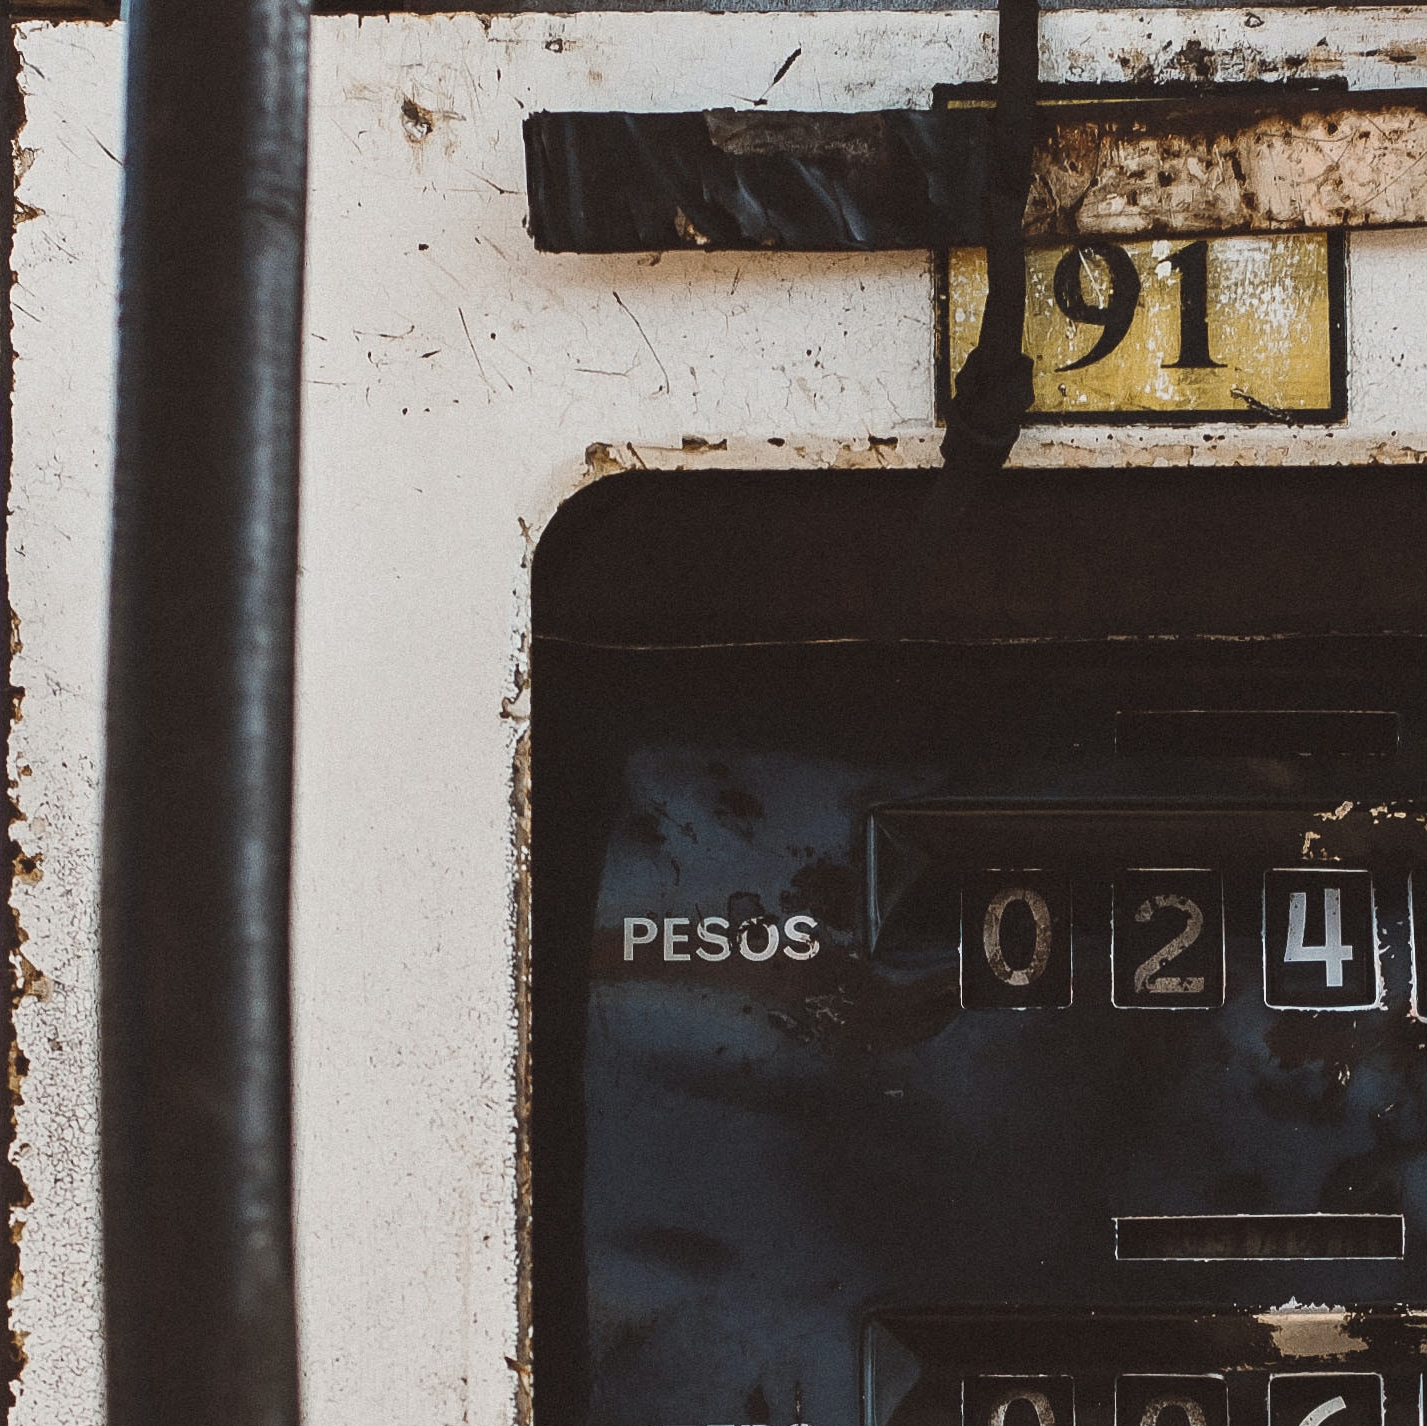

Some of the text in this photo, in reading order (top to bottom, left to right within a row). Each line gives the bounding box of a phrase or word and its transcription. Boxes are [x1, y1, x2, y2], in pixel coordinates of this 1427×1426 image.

[1054, 240, 1229, 372] 91
[622, 913, 821, 963] PESOS
[1280, 887, 1355, 989] 4
